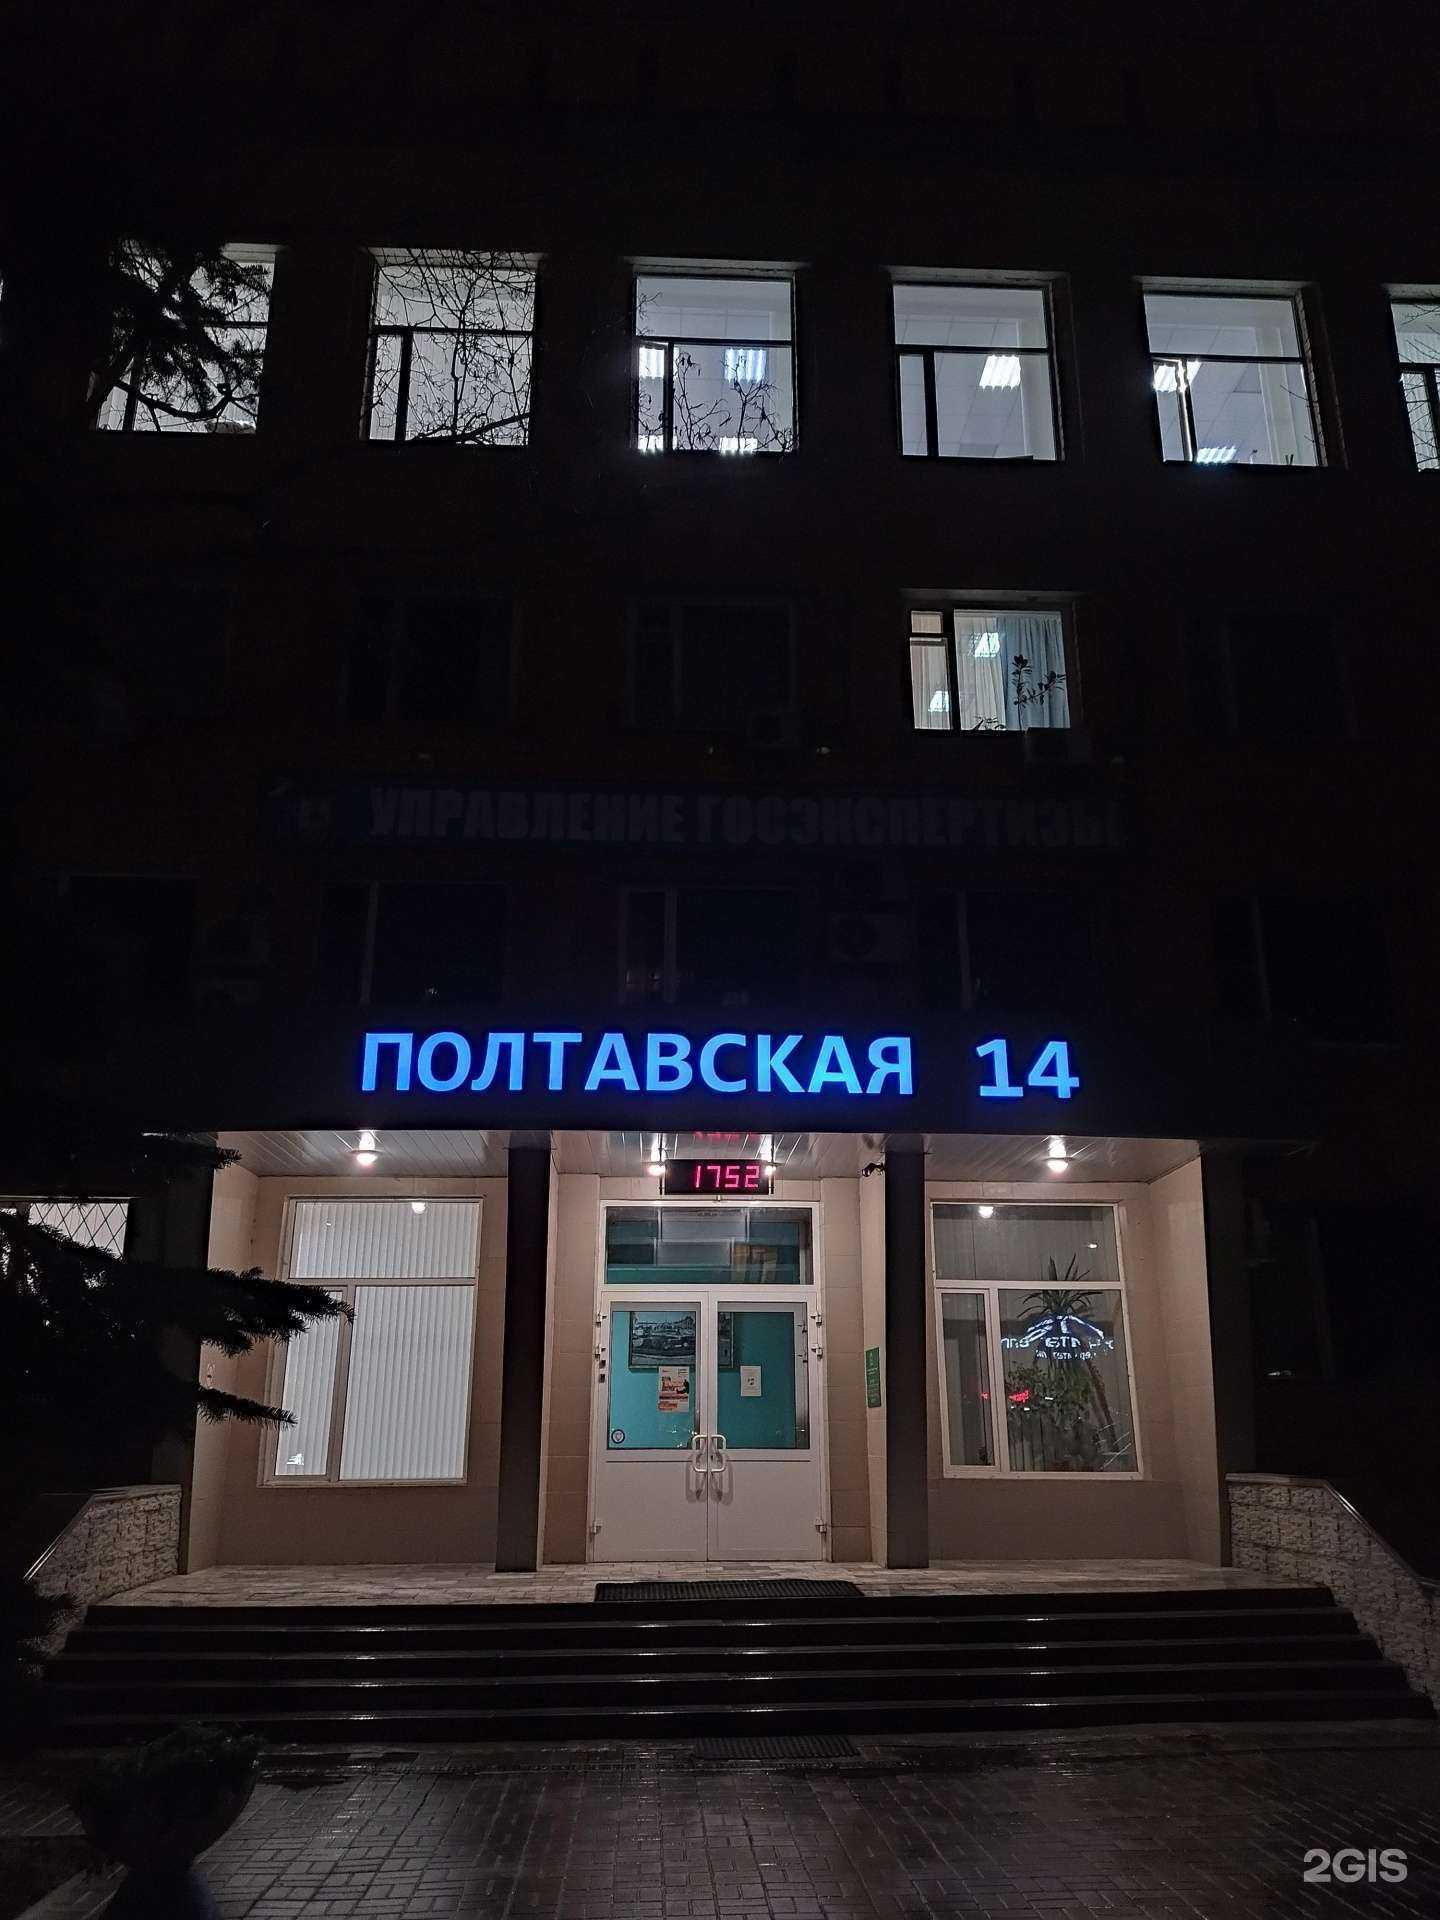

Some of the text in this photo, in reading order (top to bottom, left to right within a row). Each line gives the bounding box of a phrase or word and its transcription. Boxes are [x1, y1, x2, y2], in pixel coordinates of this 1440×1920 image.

[369, 787, 1122, 847] УПРАВЛЕНИЕ ГОСЭКСПЕРТИЗЫ
[361, 1032, 1081, 1100] ПОЛТАВСКАЯ 14
